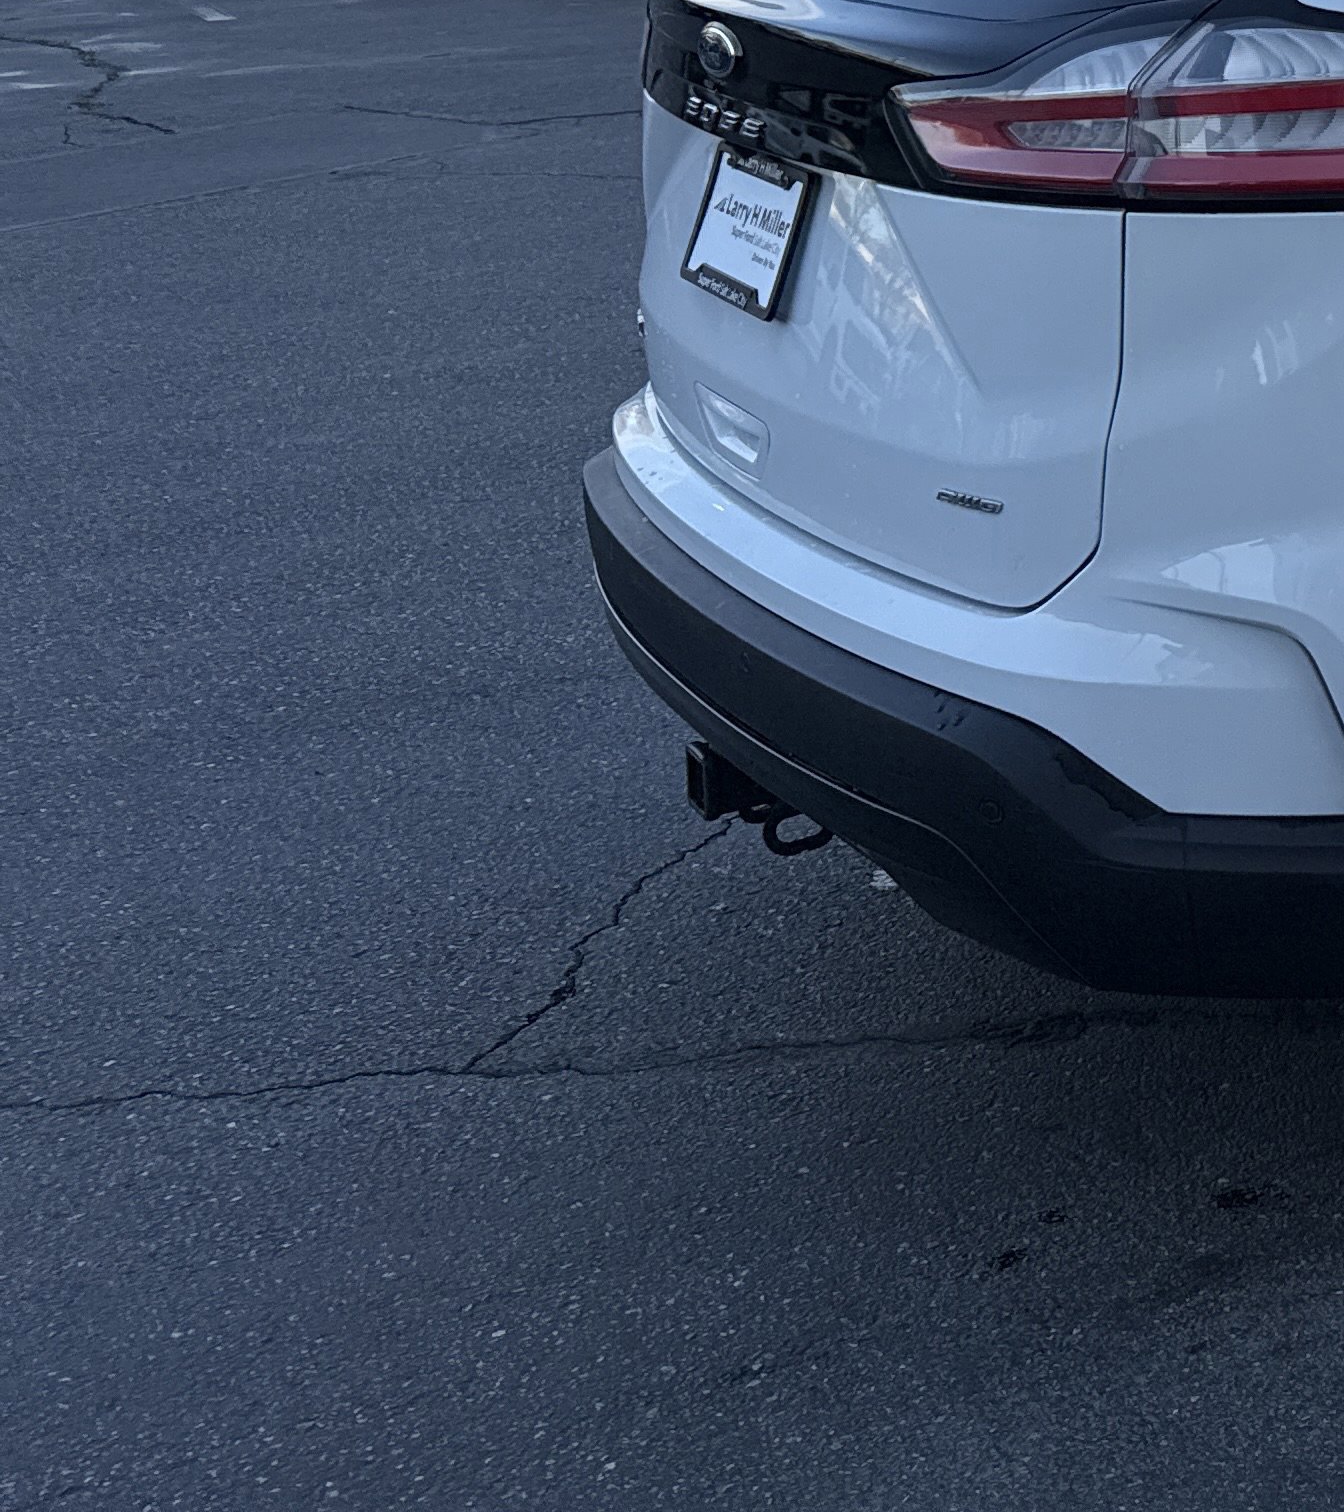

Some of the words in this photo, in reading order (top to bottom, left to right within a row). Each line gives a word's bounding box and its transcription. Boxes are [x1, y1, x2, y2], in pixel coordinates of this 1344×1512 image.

[726, 193, 752, 228] Larry
[749, 203, 762, 227] H
[758, 207, 790, 239] Miller
